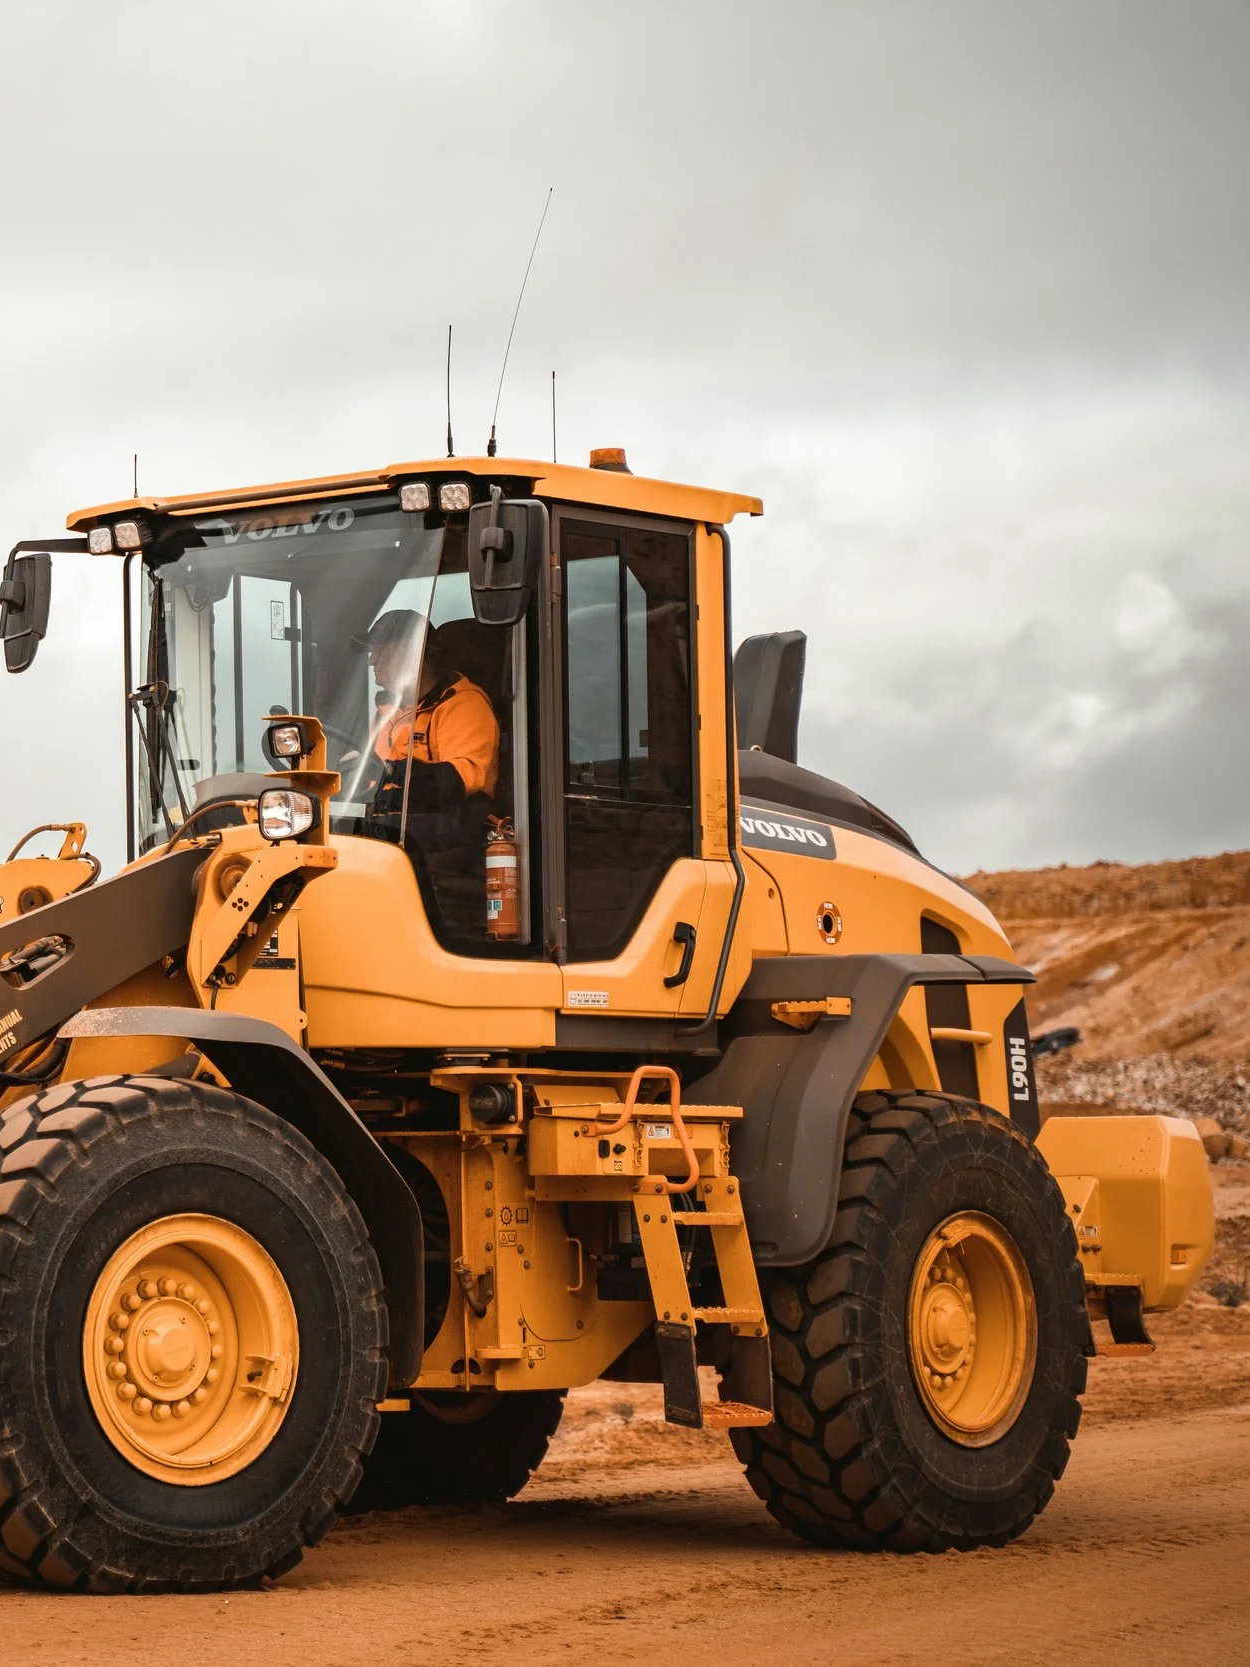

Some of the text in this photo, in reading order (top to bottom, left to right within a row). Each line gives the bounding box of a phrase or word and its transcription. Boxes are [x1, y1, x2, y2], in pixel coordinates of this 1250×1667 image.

[218, 507, 355, 544] VOLVO
[740, 816, 828, 847] VOLVO
[1009, 1037, 1030, 1101] L90H
